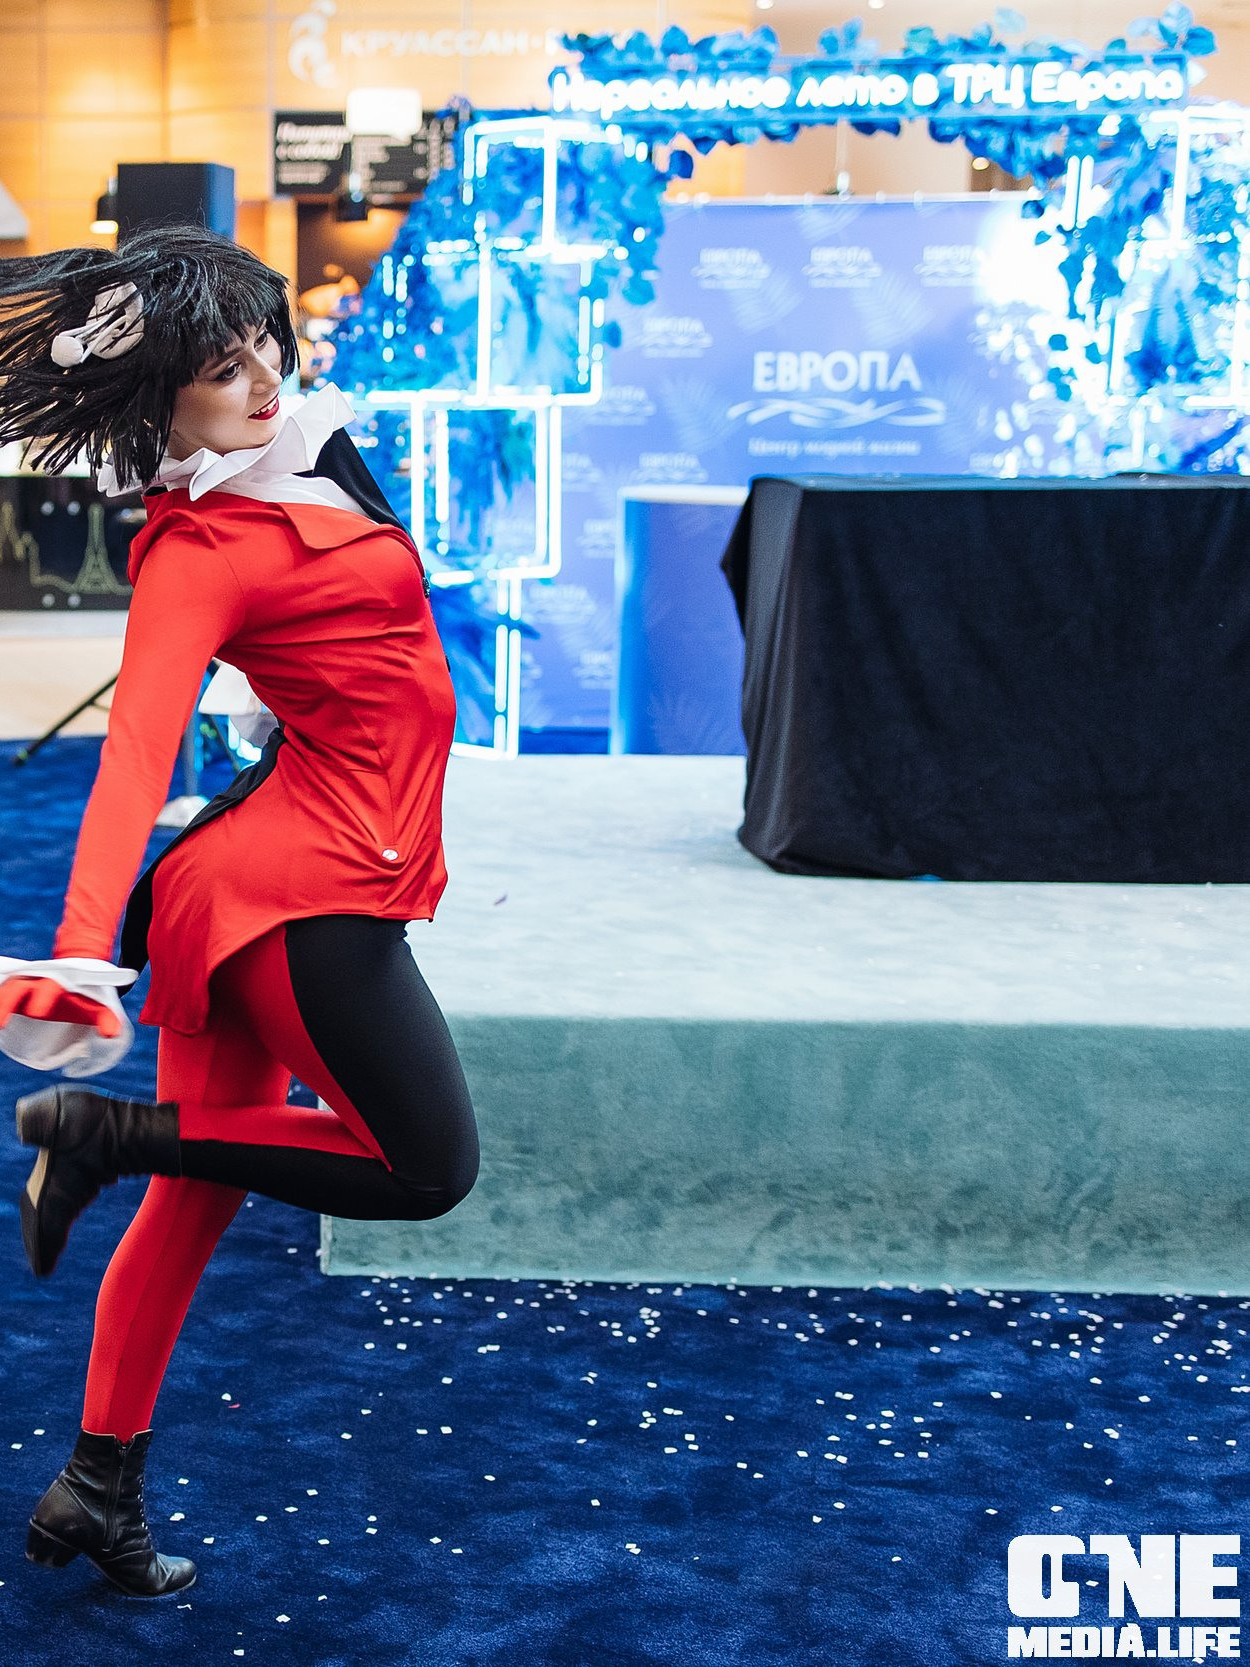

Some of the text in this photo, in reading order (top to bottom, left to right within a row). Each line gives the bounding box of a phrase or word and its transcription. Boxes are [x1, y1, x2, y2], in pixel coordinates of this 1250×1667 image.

[912, 72, 940, 107] в
[945, 63, 1026, 110] ТРЦ
[1031, 61, 1184, 111] Европа
[752, 350, 922, 393] ЕВРОПА
